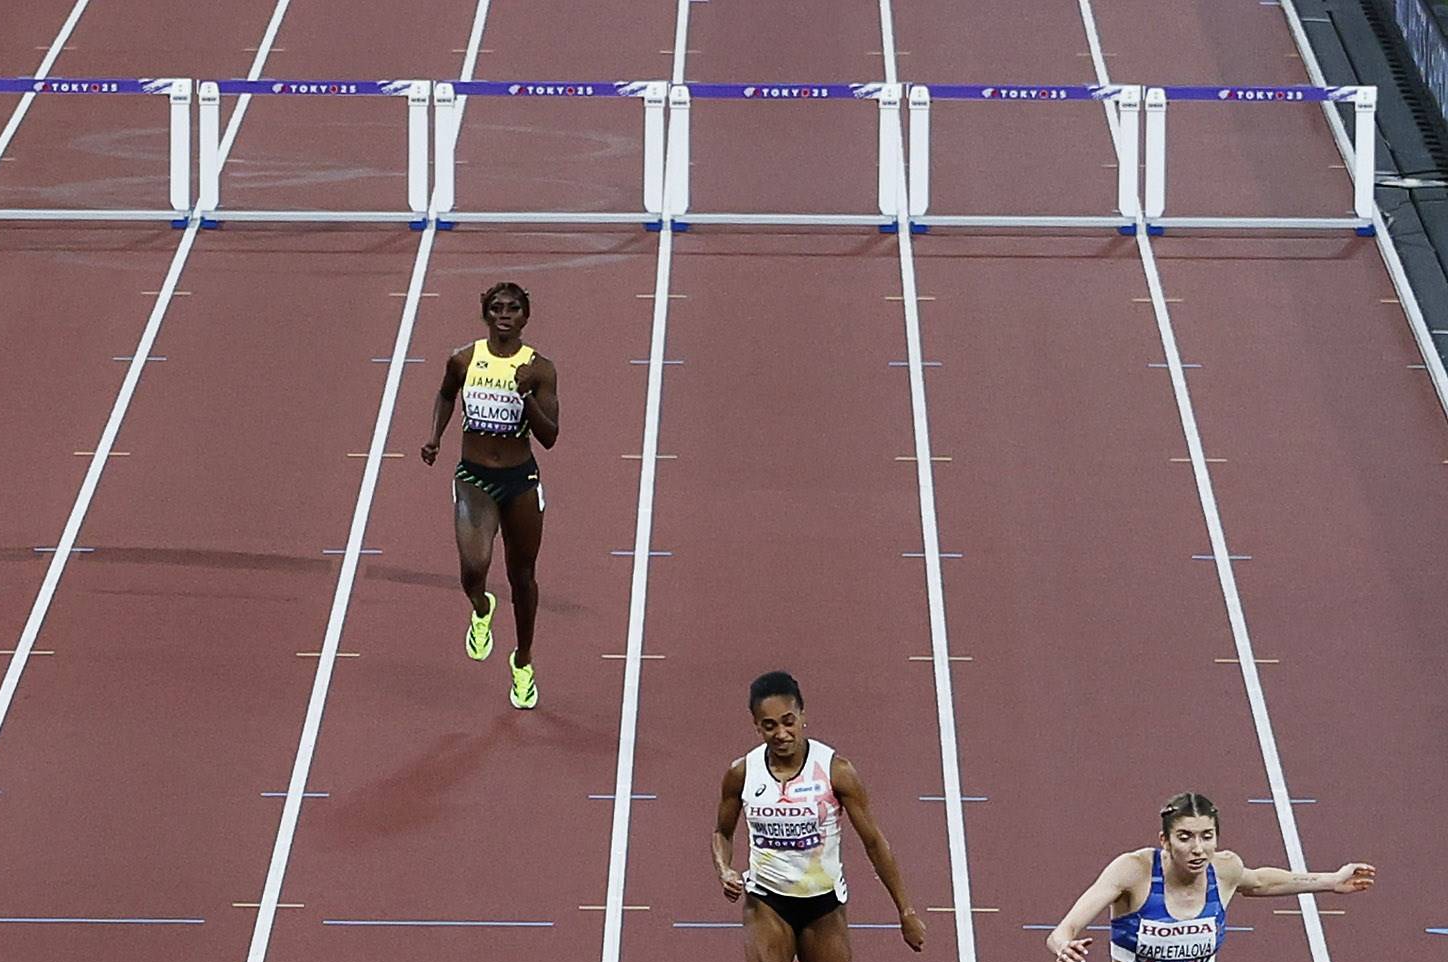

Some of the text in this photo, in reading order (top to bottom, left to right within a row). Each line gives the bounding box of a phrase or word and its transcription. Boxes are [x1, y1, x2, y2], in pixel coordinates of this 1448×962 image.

[470, 376, 515, 391] JAMAIC
[466, 391, 521, 405] HONDA
[467, 404, 520, 421] SALMON
[750, 806, 816, 817] HONDA
[1142, 923, 1213, 937] HONDA
